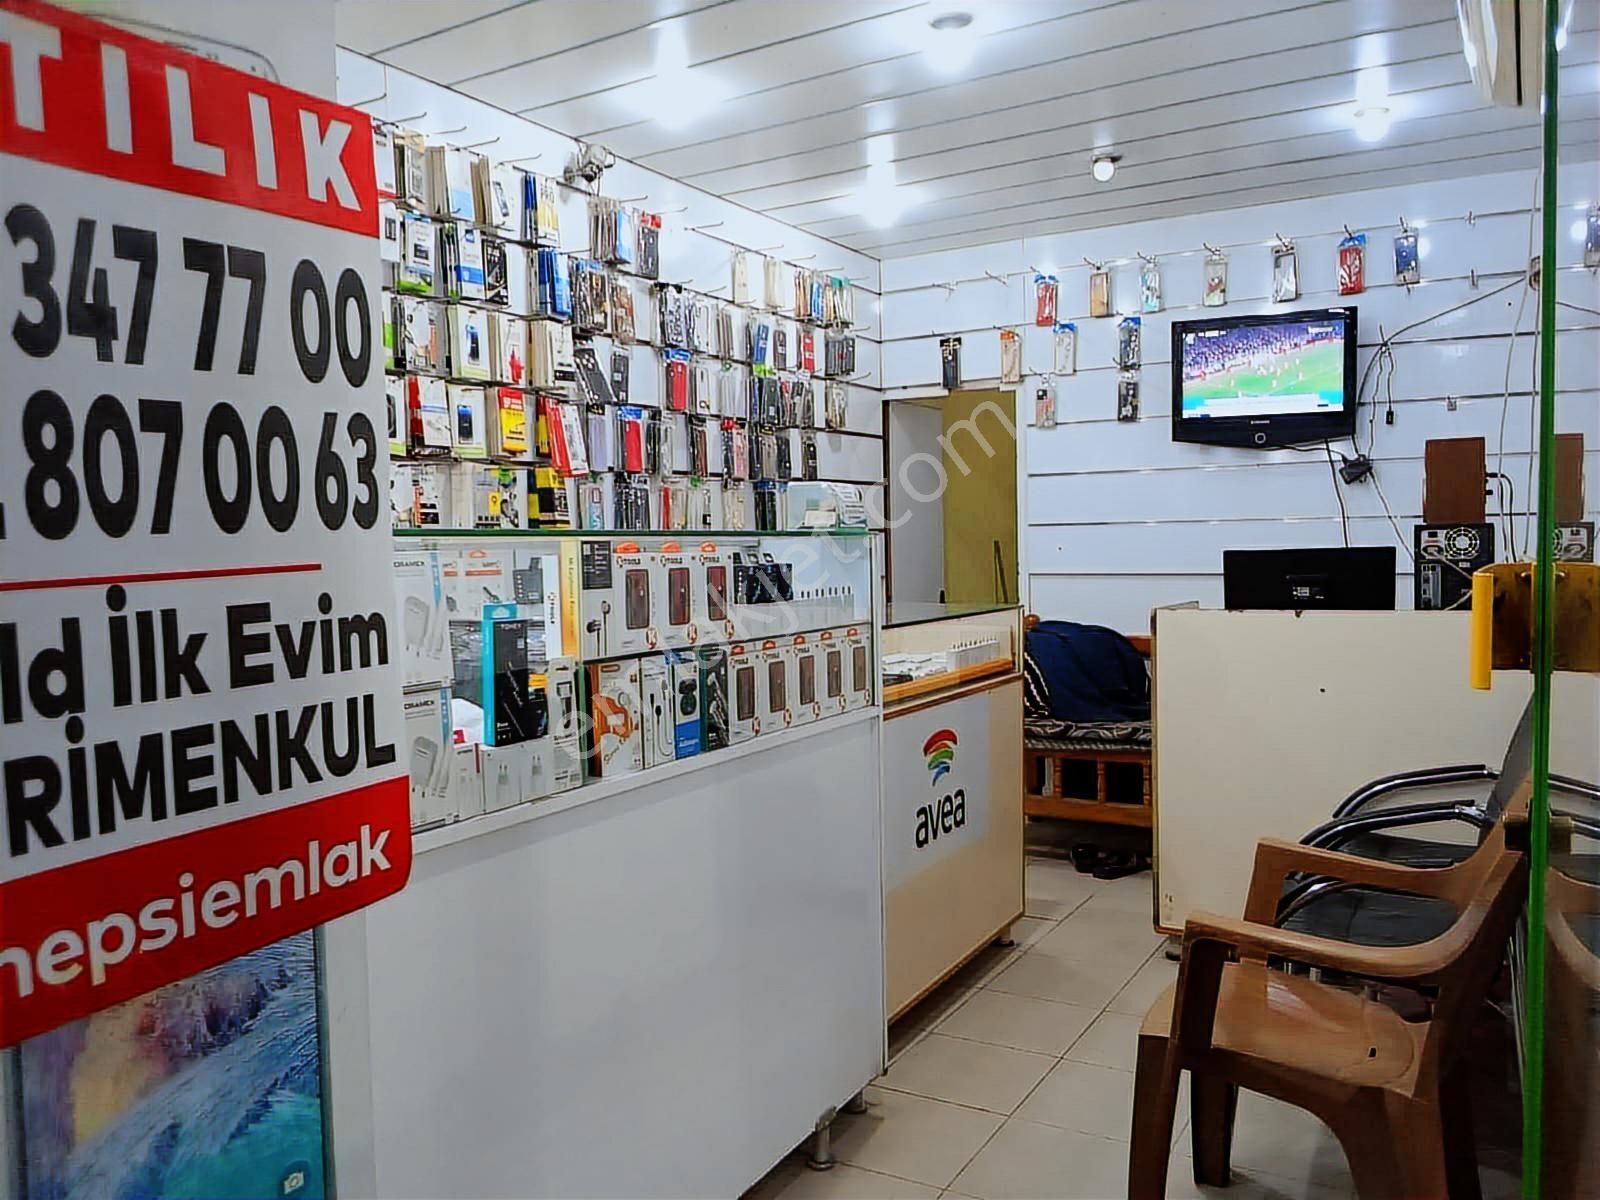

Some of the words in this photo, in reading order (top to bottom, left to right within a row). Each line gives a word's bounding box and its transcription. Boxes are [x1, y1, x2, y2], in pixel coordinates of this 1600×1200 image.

[5, 203, 158, 366] 347
[183, 237, 266, 375] 77
[291, 259, 371, 388] 00
[23, 389, 183, 540] 807
[203, 402, 300, 534] 00
[315, 412, 379, 531] 63
[106, 584, 211, 707] İlk
[226, 592, 388, 689] Evim
[4, 694, 396, 857] RİMENKUL
[915, 789, 966, 849] avea
